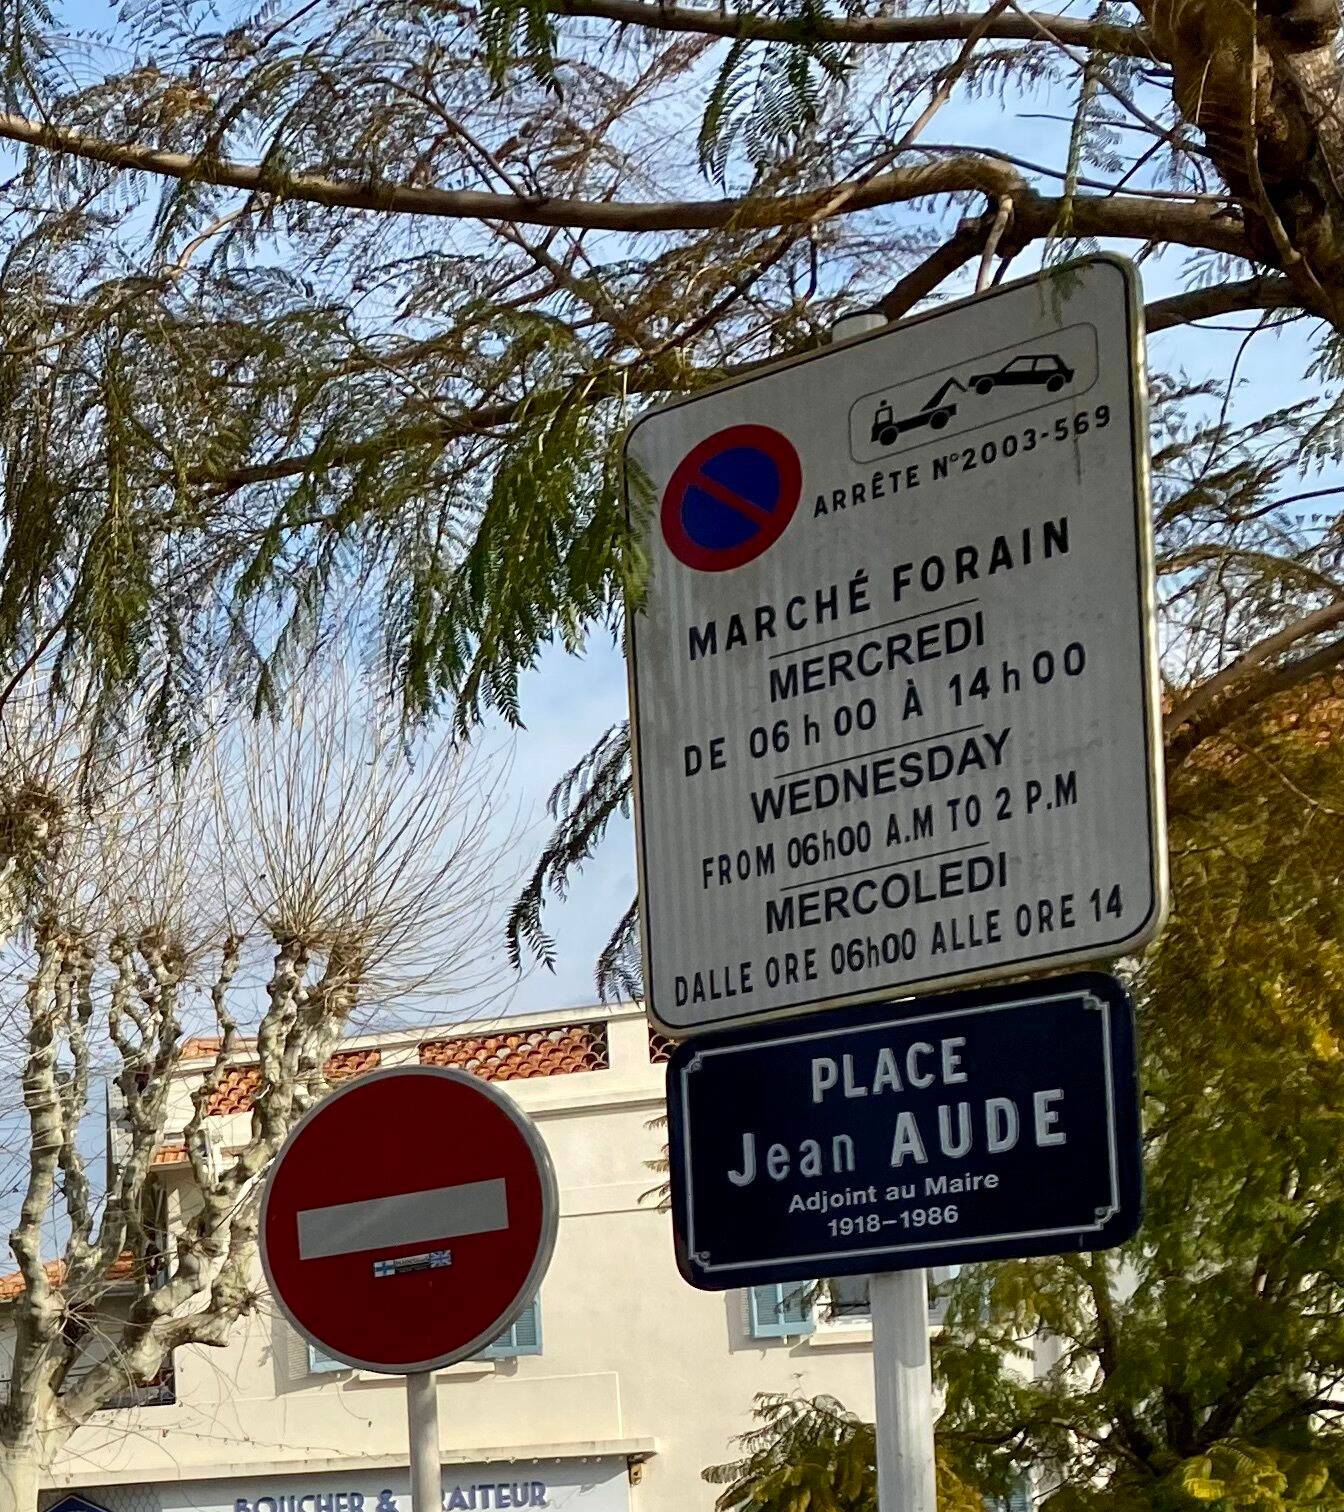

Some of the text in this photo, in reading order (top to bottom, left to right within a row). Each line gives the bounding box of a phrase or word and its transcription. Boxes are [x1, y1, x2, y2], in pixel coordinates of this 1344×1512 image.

[814, 464, 920, 518] ARRÊTE
[689, 517, 1069, 661] MARCHÉ FORAIN
[770, 611, 984, 703] MERCREDI
[685, 737, 727, 777] DE
[902, 679, 923, 720] À
[750, 727, 1011, 824] WEDNESDAY
[703, 770, 1077, 889] FROM 06h00 A.M TO 2 P.M
[766, 852, 1006, 934] MERCOLEDI
[675, 884, 1123, 1007] DALLE ORE 06h00 ALLE ORE 14
[812, 1037, 968, 1103] PLACE
[728, 1089, 1066, 1186] Jean AUDE
[788, 1172, 999, 1213] Adjoint au Maire
[442, 1481, 547, 1512] AITEUR
